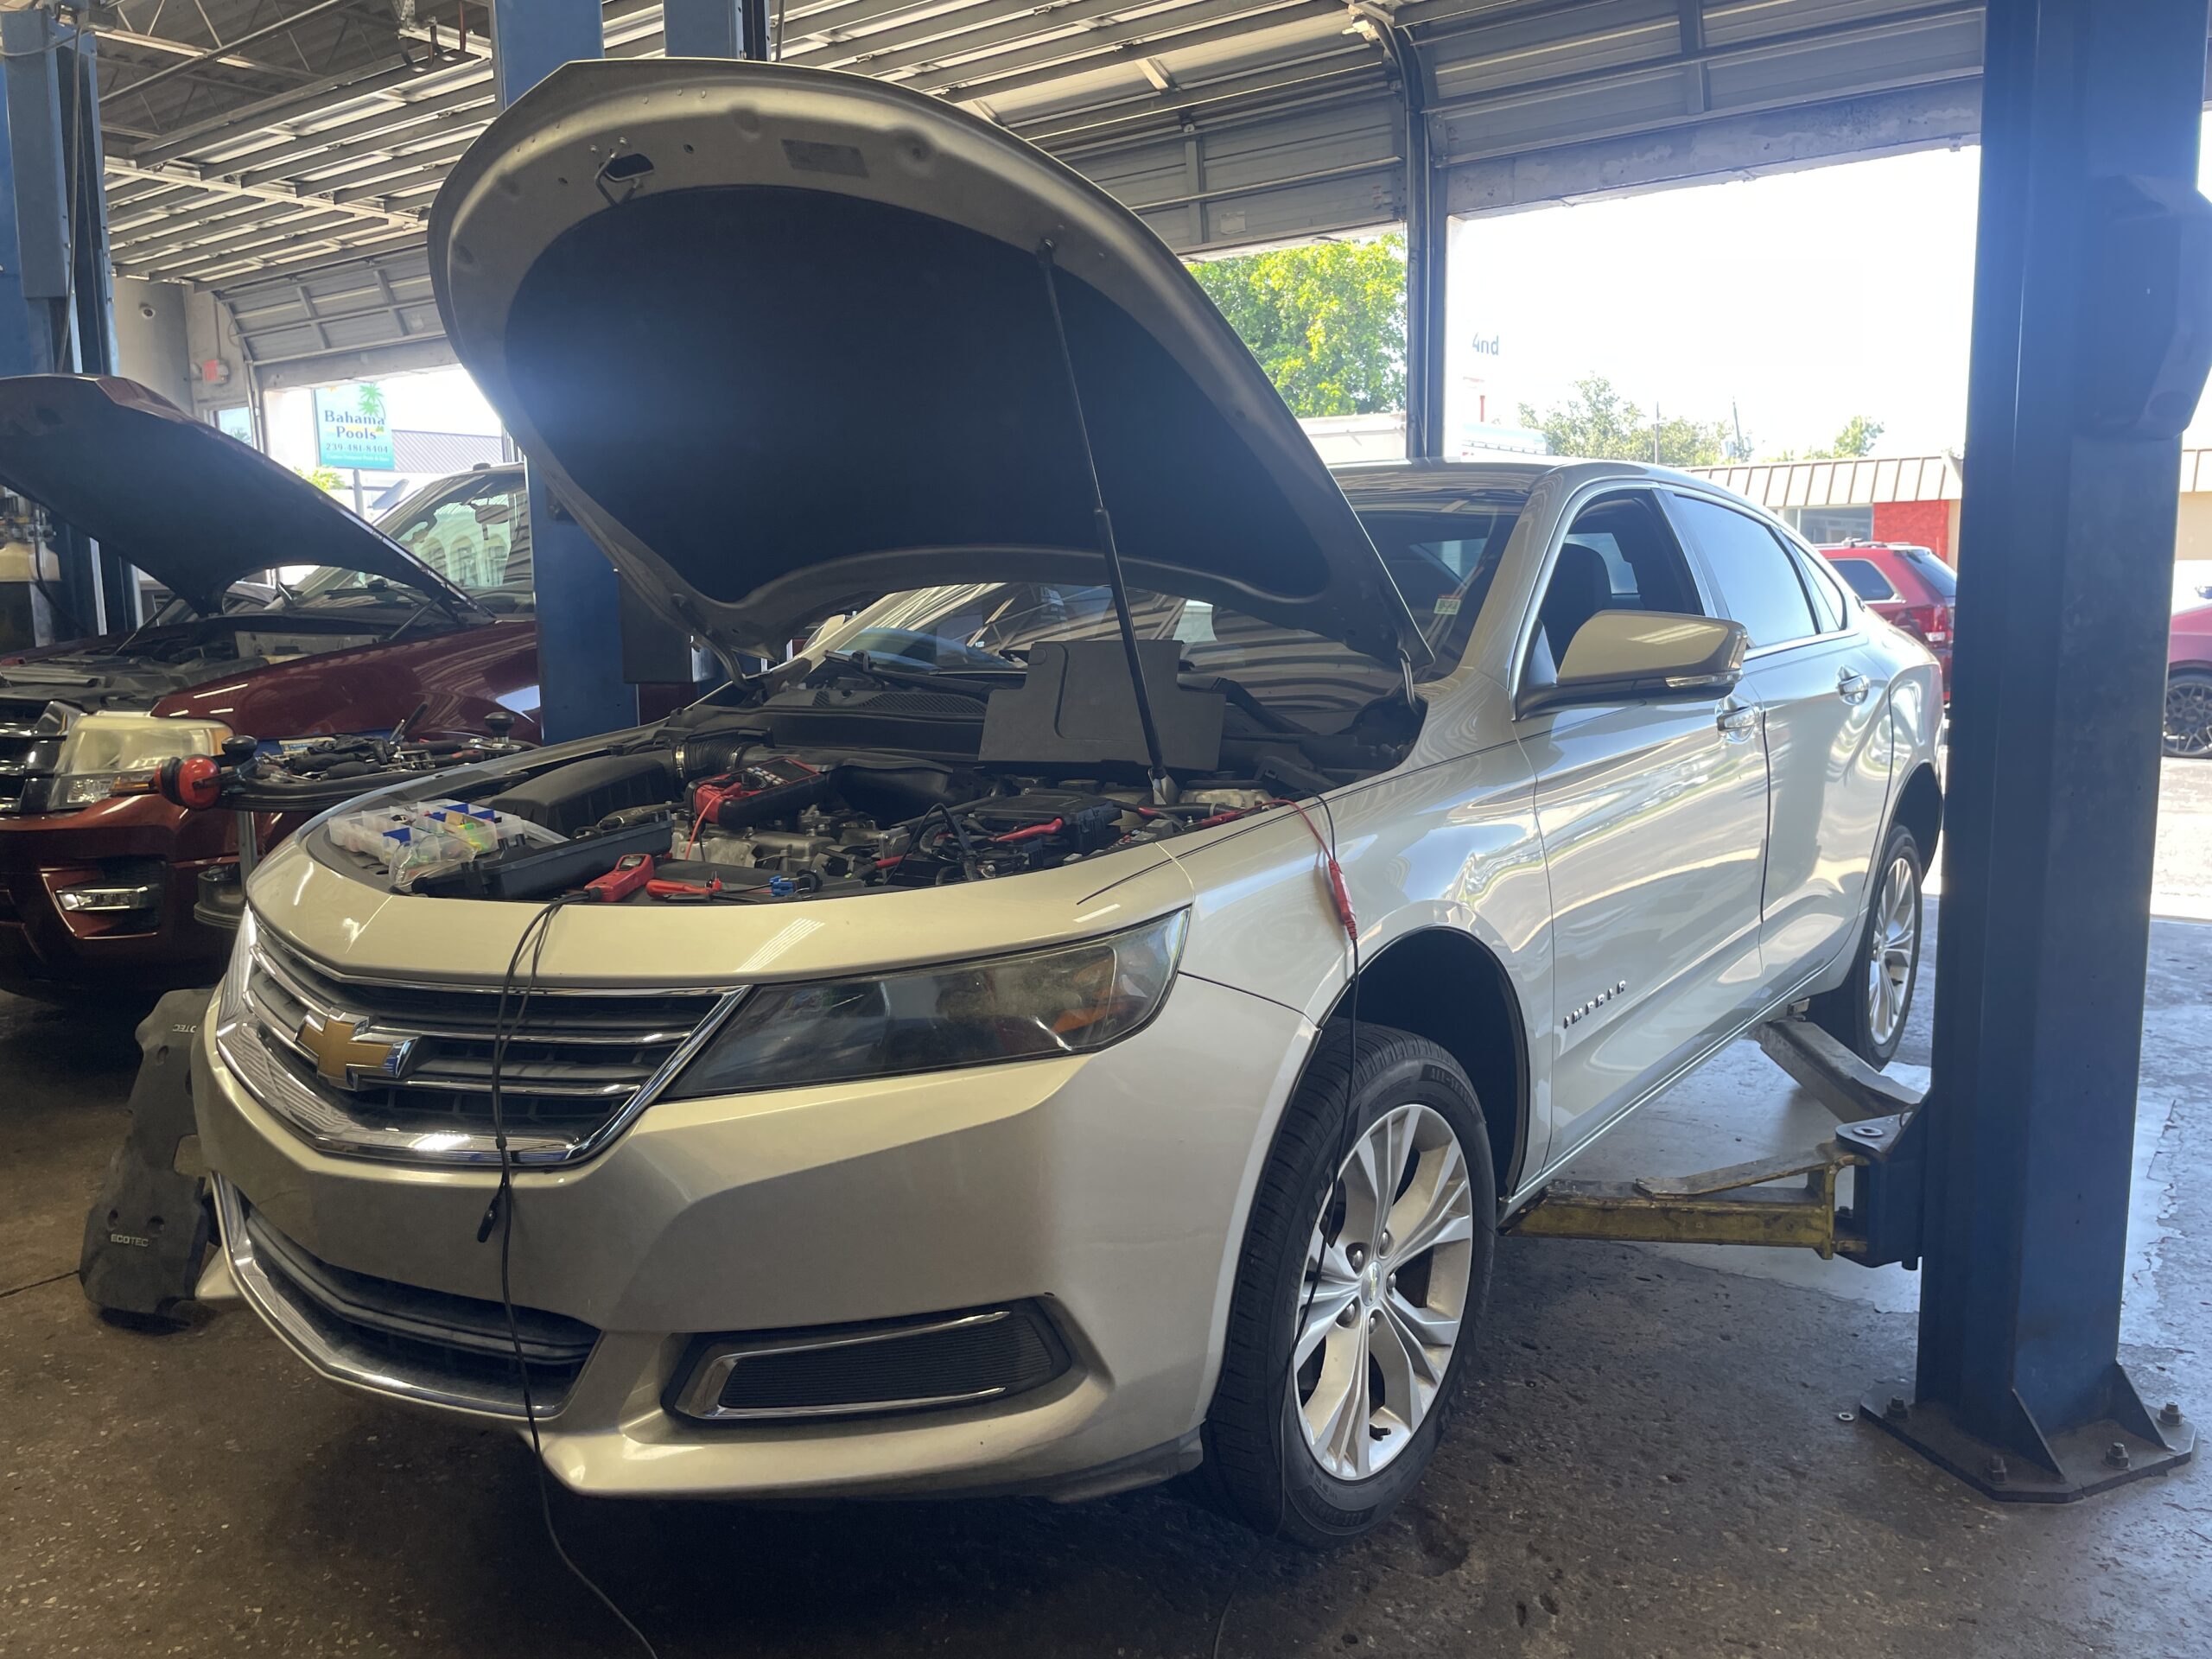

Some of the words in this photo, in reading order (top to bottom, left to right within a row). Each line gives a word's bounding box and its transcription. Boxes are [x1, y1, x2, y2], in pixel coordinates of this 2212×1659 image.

[324, 410, 385, 426] Bahama
[336, 426, 377, 441] Pools
[172, 1023, 197, 1033] OTEC
[110, 1233, 149, 1248] ECOTEC
